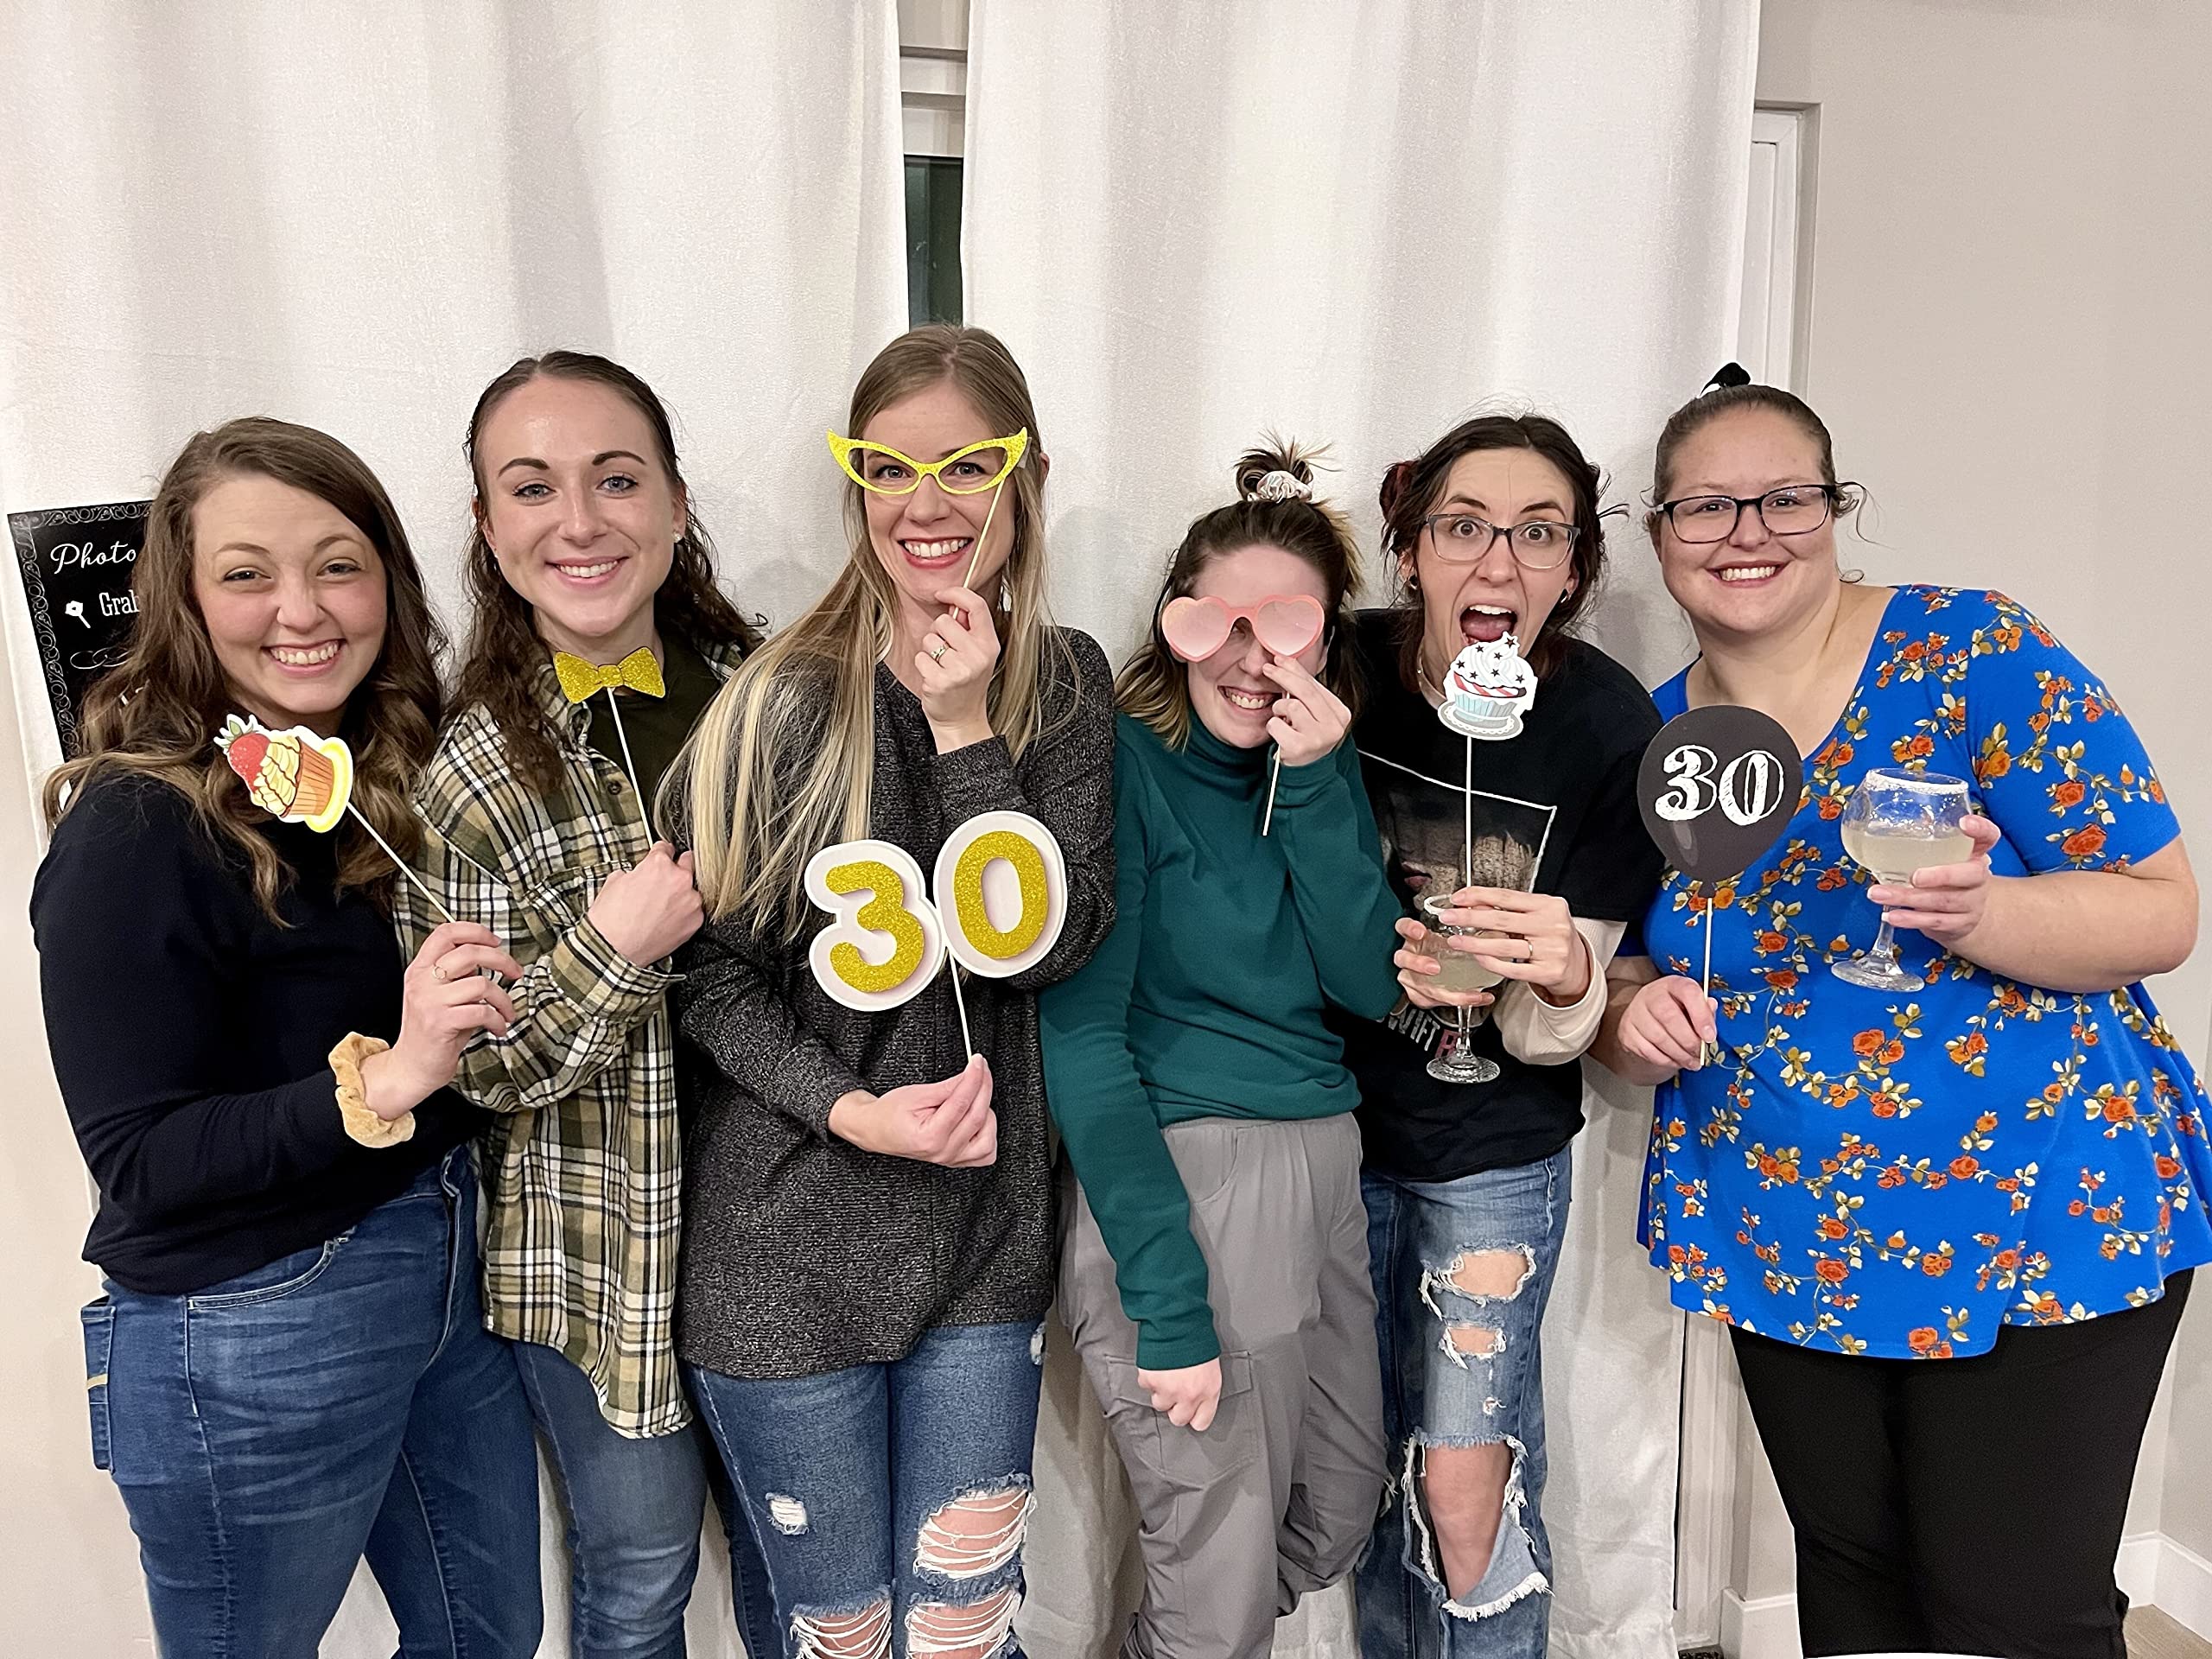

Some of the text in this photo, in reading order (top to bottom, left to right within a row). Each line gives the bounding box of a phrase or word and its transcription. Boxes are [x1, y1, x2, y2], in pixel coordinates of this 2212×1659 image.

[50, 541, 137, 575] Photo
[1655, 745, 1784, 826] 30
[826, 831, 1048, 992] 30
